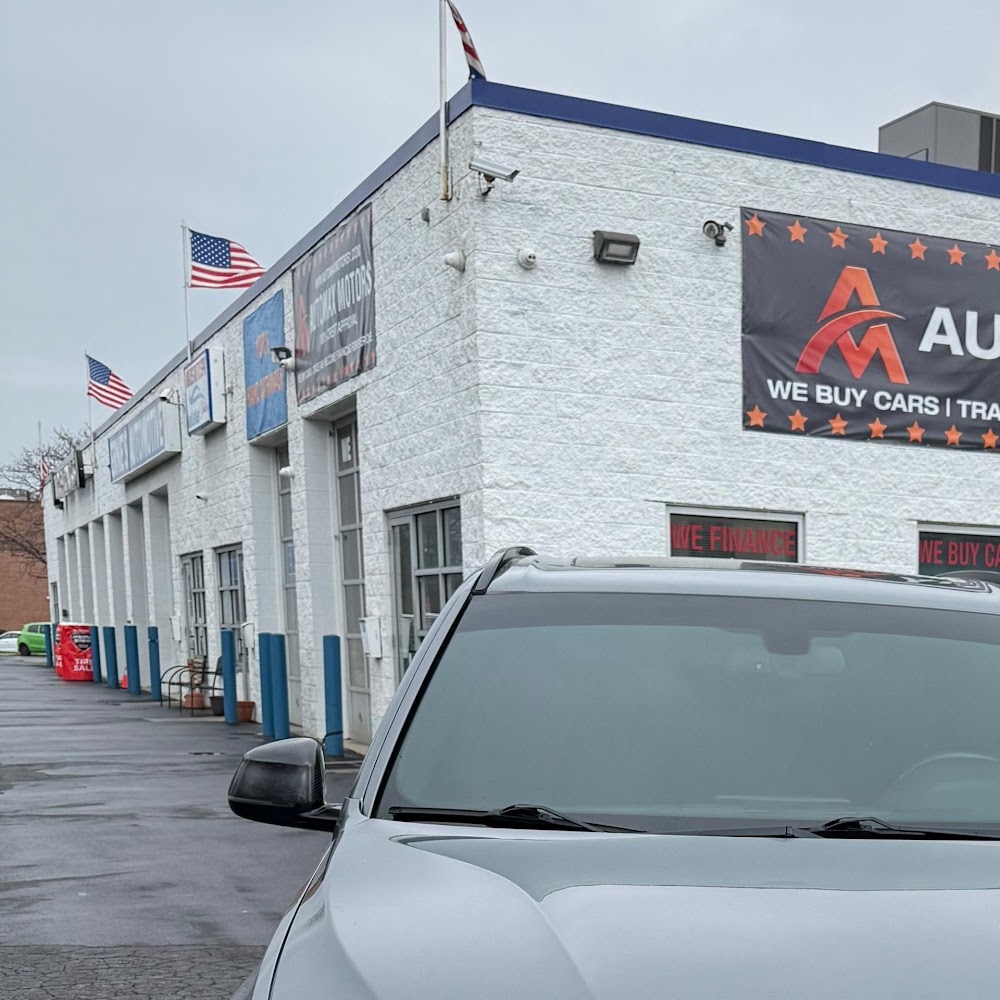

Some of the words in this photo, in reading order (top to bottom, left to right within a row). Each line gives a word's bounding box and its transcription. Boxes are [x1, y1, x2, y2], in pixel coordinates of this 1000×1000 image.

[337, 260, 372, 312] MOTORS
[767, 379, 809, 402] WE
[815, 385, 868, 408] BUY
[873, 391, 940, 415] CARS
[670, 523, 703, 551] WE
[709, 525, 796, 557] FINANCE
[919, 540, 943, 565] WE
[947, 541, 980, 566] BUY
